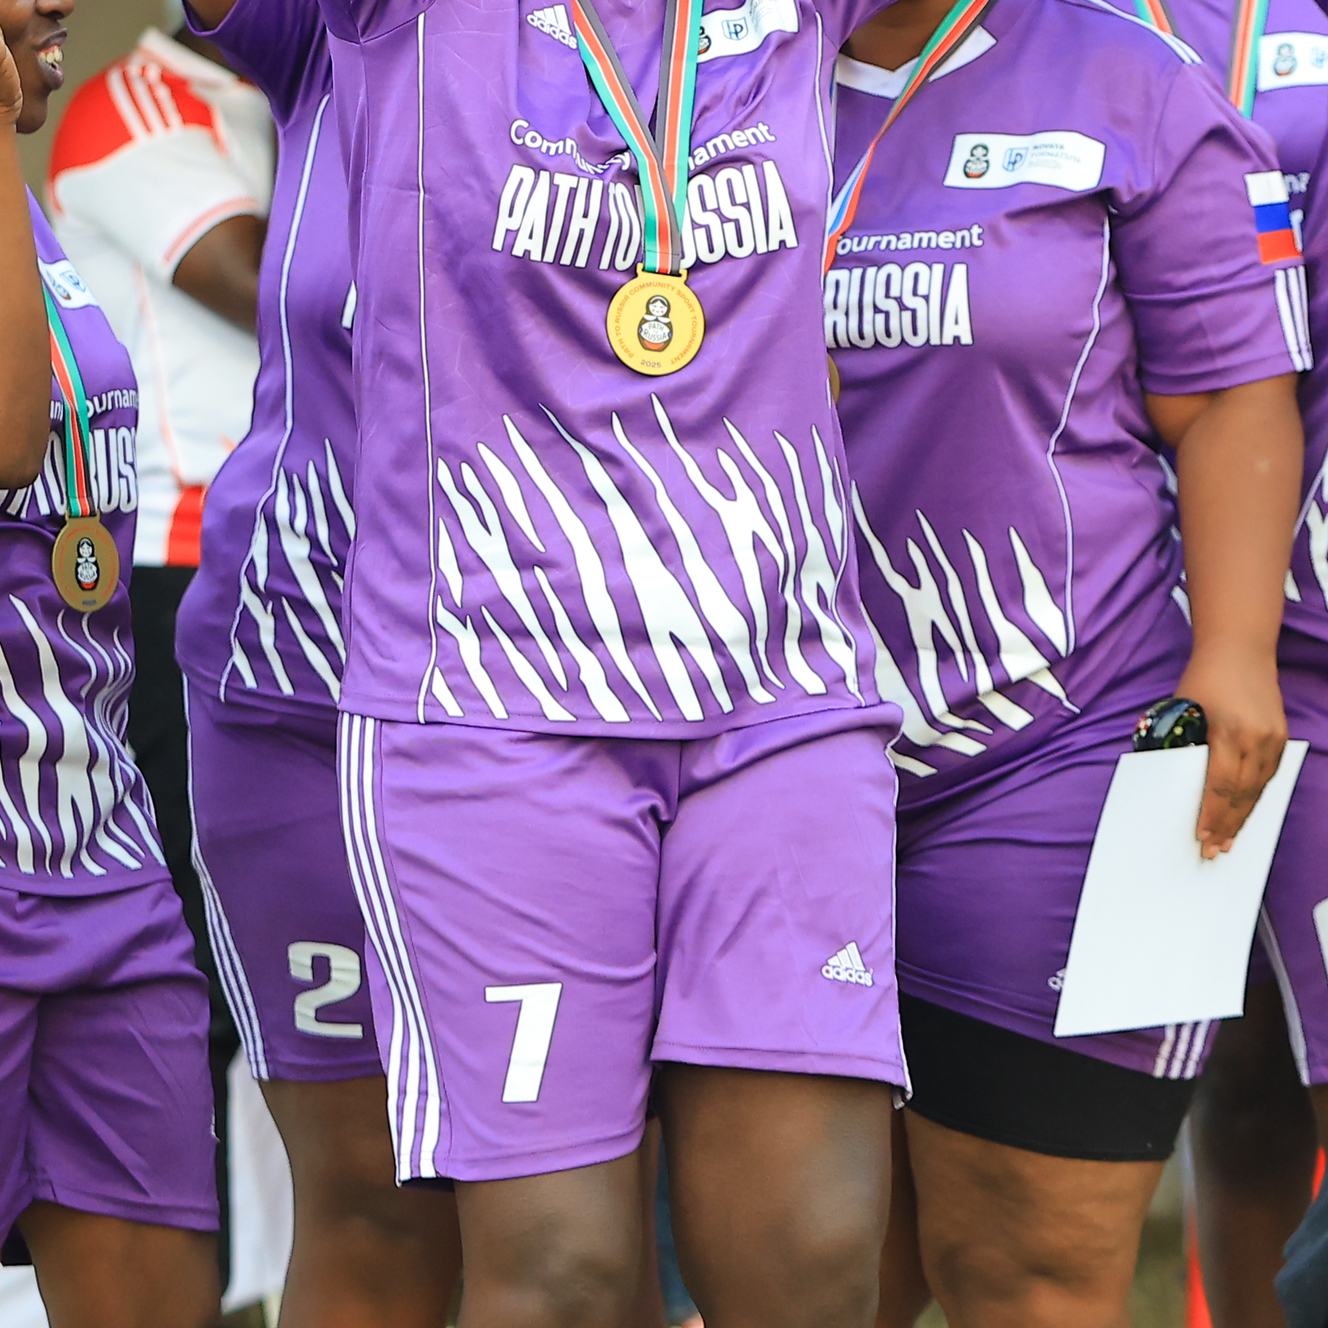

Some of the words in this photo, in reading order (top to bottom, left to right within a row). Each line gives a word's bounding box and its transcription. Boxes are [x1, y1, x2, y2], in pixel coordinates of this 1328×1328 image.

[526, 14, 578, 50] adidas
[492, 163, 604, 269] PATH
[634, 160, 799, 270] SSIA
[629, 281, 676, 296] COMMUNITY
[825, 260, 975, 351] RUSSIA
[640, 359, 662, 368] 2025
[286, 941, 364, 1040] 2
[821, 964, 874, 988] adidas
[484, 982, 564, 1104] 7
